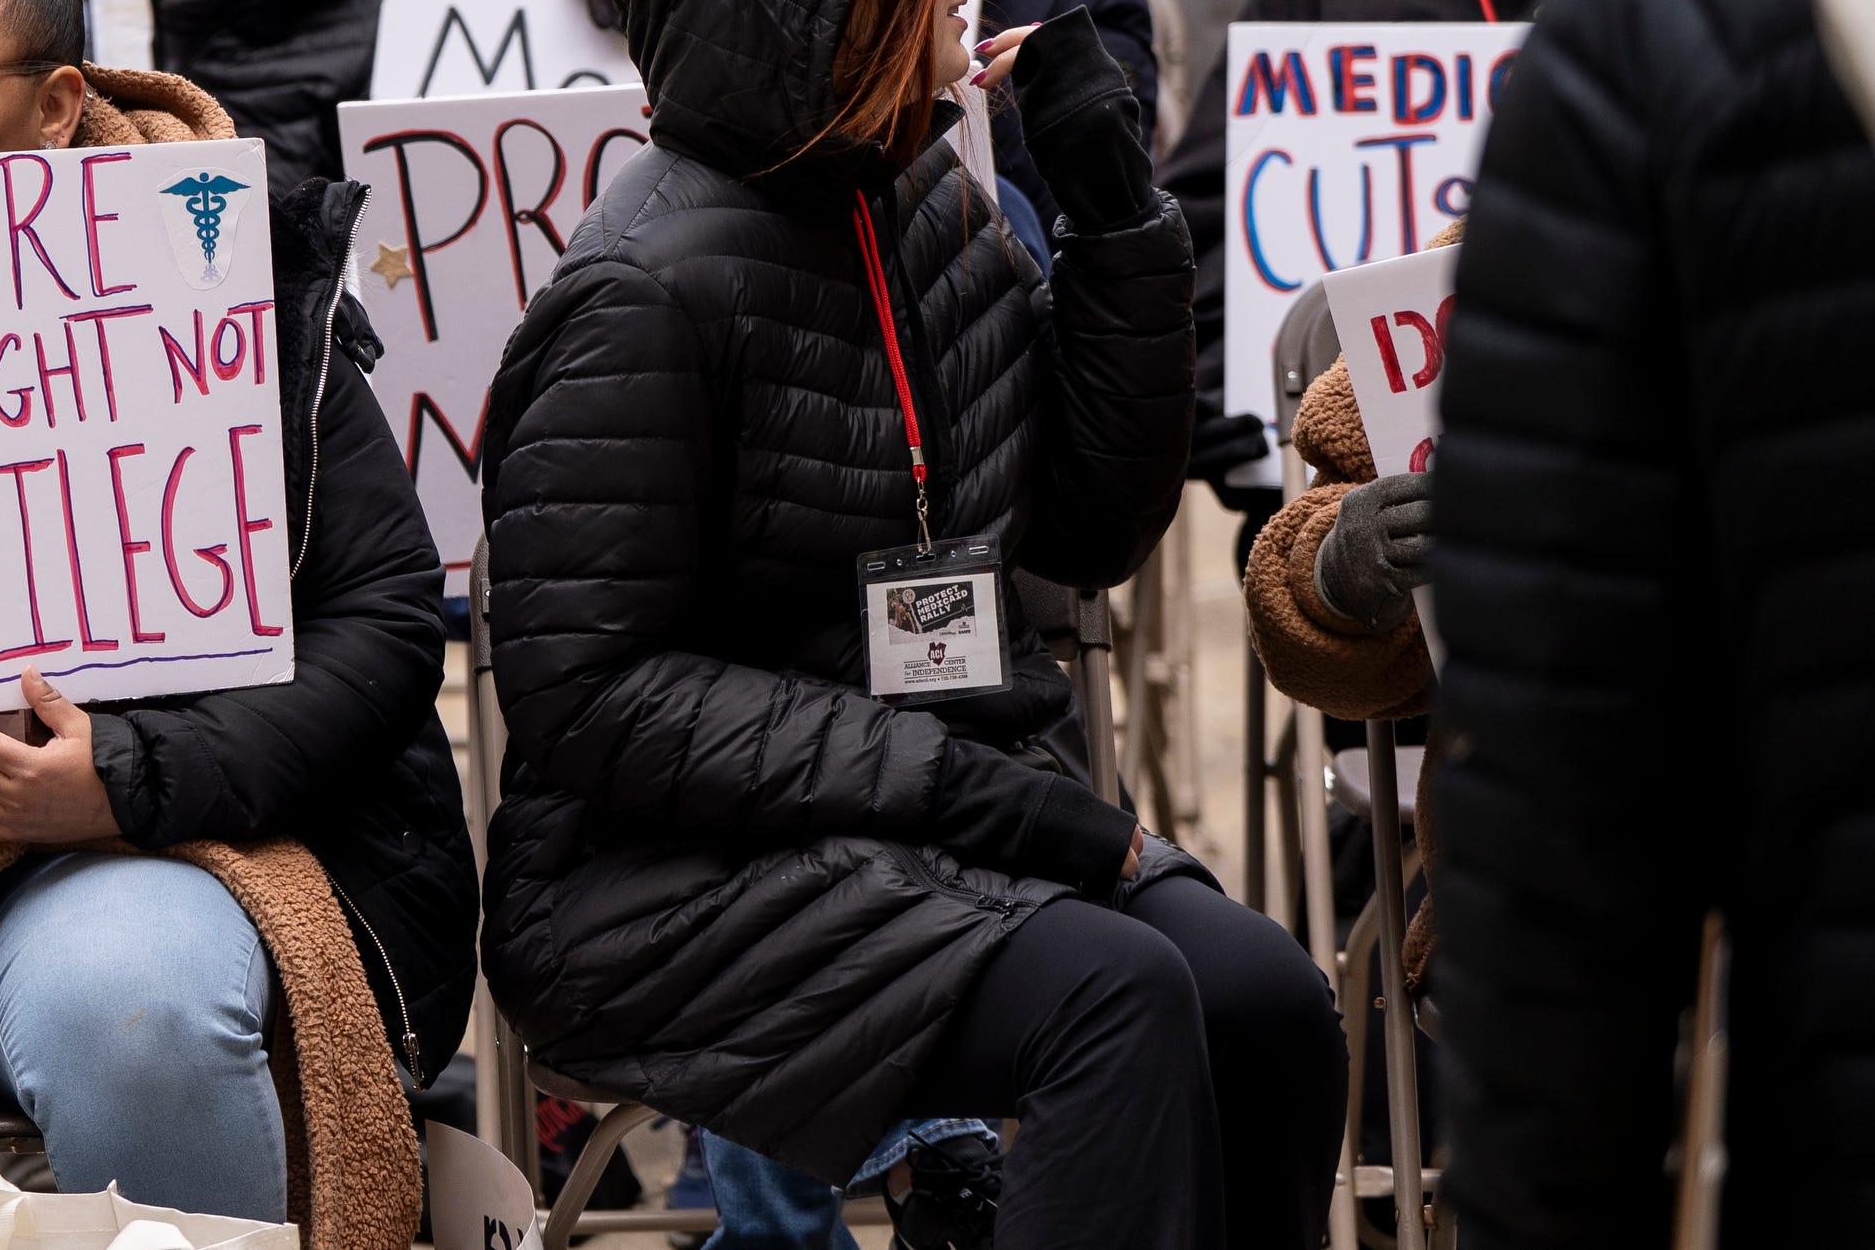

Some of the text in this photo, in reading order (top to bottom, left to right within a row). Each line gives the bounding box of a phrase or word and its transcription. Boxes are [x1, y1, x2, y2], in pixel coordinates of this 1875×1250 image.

[159, 300, 276, 405] NOT
[915, 585, 959, 608] PROTECT
[917, 589, 968, 616] MEDICAID
[920, 604, 951, 623] RALLY
[930, 649, 943, 660] ACI
[904, 661, 931, 670] ALLIANCE
[912, 665, 967, 677] INDEPENDENCE
